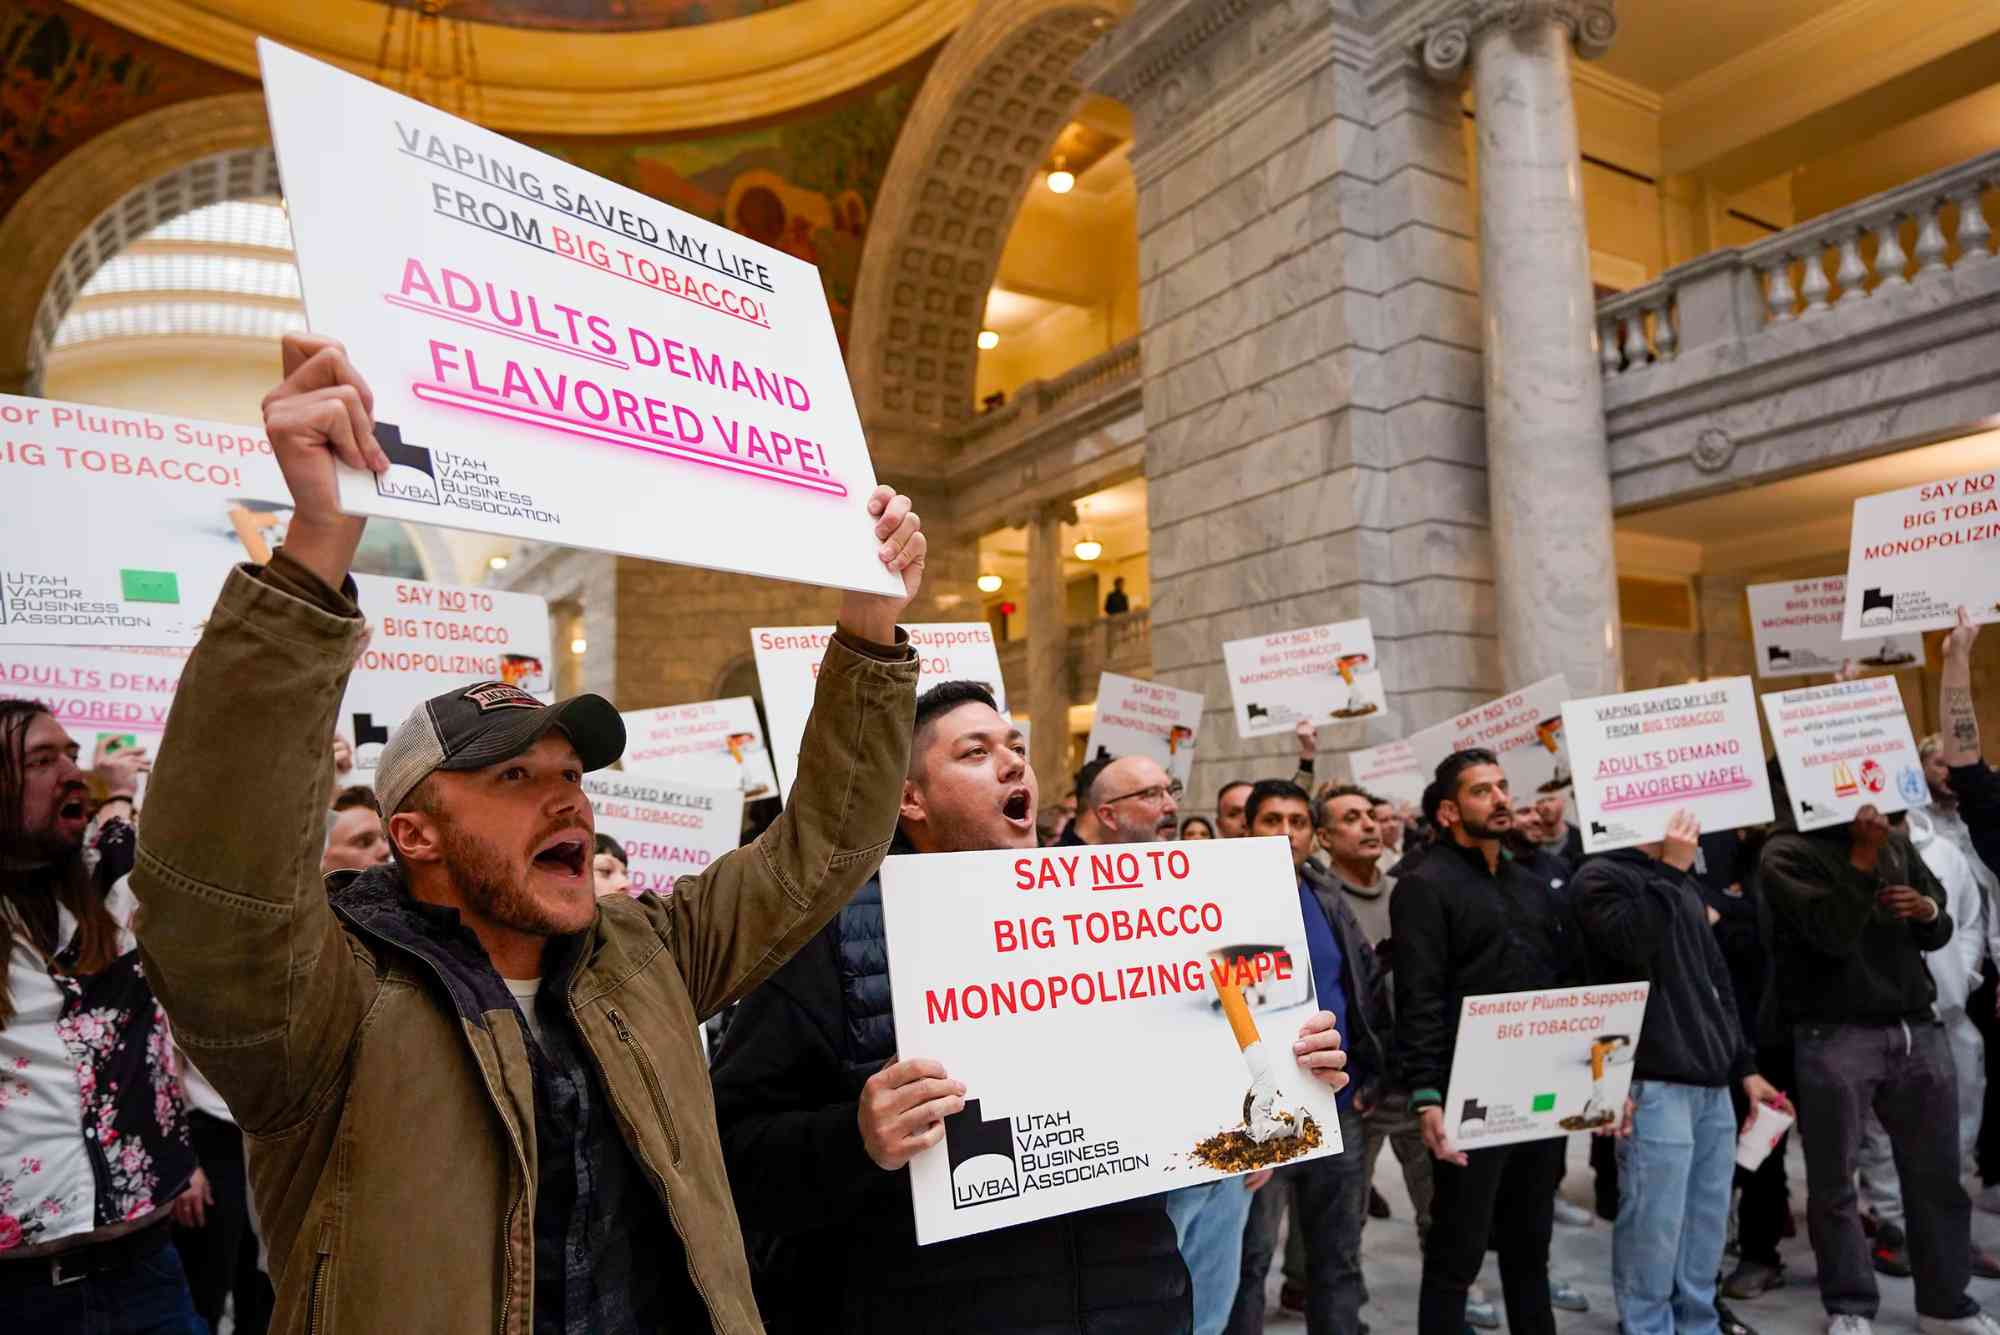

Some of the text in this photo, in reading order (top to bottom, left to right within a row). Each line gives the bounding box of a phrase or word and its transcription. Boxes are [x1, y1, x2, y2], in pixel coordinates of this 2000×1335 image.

[393, 120, 773, 288] VAPING SAVED MY LIFE
[431, 182, 769, 323] FROM BIG TOBACCO!
[401, 258, 810, 412] ADULTS DEMAND
[428, 339, 830, 476] FLAVORED VAPE!
[51, 407, 165, 441] Plumb
[56, 446, 241, 487] TOBACCO!
[435, 449, 487, 471] UTAH
[436, 463, 500, 485] VAPOR
[1920, 474, 1995, 501] SAY NO
[380, 481, 435, 500] UVBA
[441, 478, 533, 506] BUSINESS
[443, 493, 561, 524] ASSOCIATION
[1903, 510, 1936, 529] BIG
[7, 571, 68, 586] UTAH
[7, 585, 83, 600] VAPOR
[10, 598, 120, 613] BUSINESS
[396, 585, 493, 612] SAY NO TO
[10, 611, 151, 627] ASSOCIATION
[383, 617, 508, 644] BIG TOBACCO
[910, 629, 991, 647] Supports
[1643, 697, 1682, 713] SAVED
[1455, 713, 1481, 729] SAY
[1479, 708, 1539, 738] TOBACCO
[1606, 722, 1640, 738] FROM
[1598, 739, 1739, 775] ADULTS DEMAND
[613, 783, 659, 800] SAVED
[686, 794, 712, 809] LIFE
[1605, 766, 1745, 801] FLAVORED VAPE!
[625, 841, 711, 865] DEMAND
[1014, 850, 1190, 890] SAY NO TO
[993, 902, 1223, 952] BIG TOBACCO
[925, 950, 1293, 1025] MONOPOLIZING VAPE
[1467, 989, 1648, 1017] Senator Plumb Supports
[1497, 1015, 1606, 1040] BIG TOBACCO!
[1016, 1110, 1071, 1132] UTAH
[1016, 1127, 1086, 1152] VAPOR
[1021, 1140, 1119, 1172] BUSINESS
[1022, 1153, 1149, 1193] ASSOCIATION
[957, 1177, 1015, 1201] UVBA
